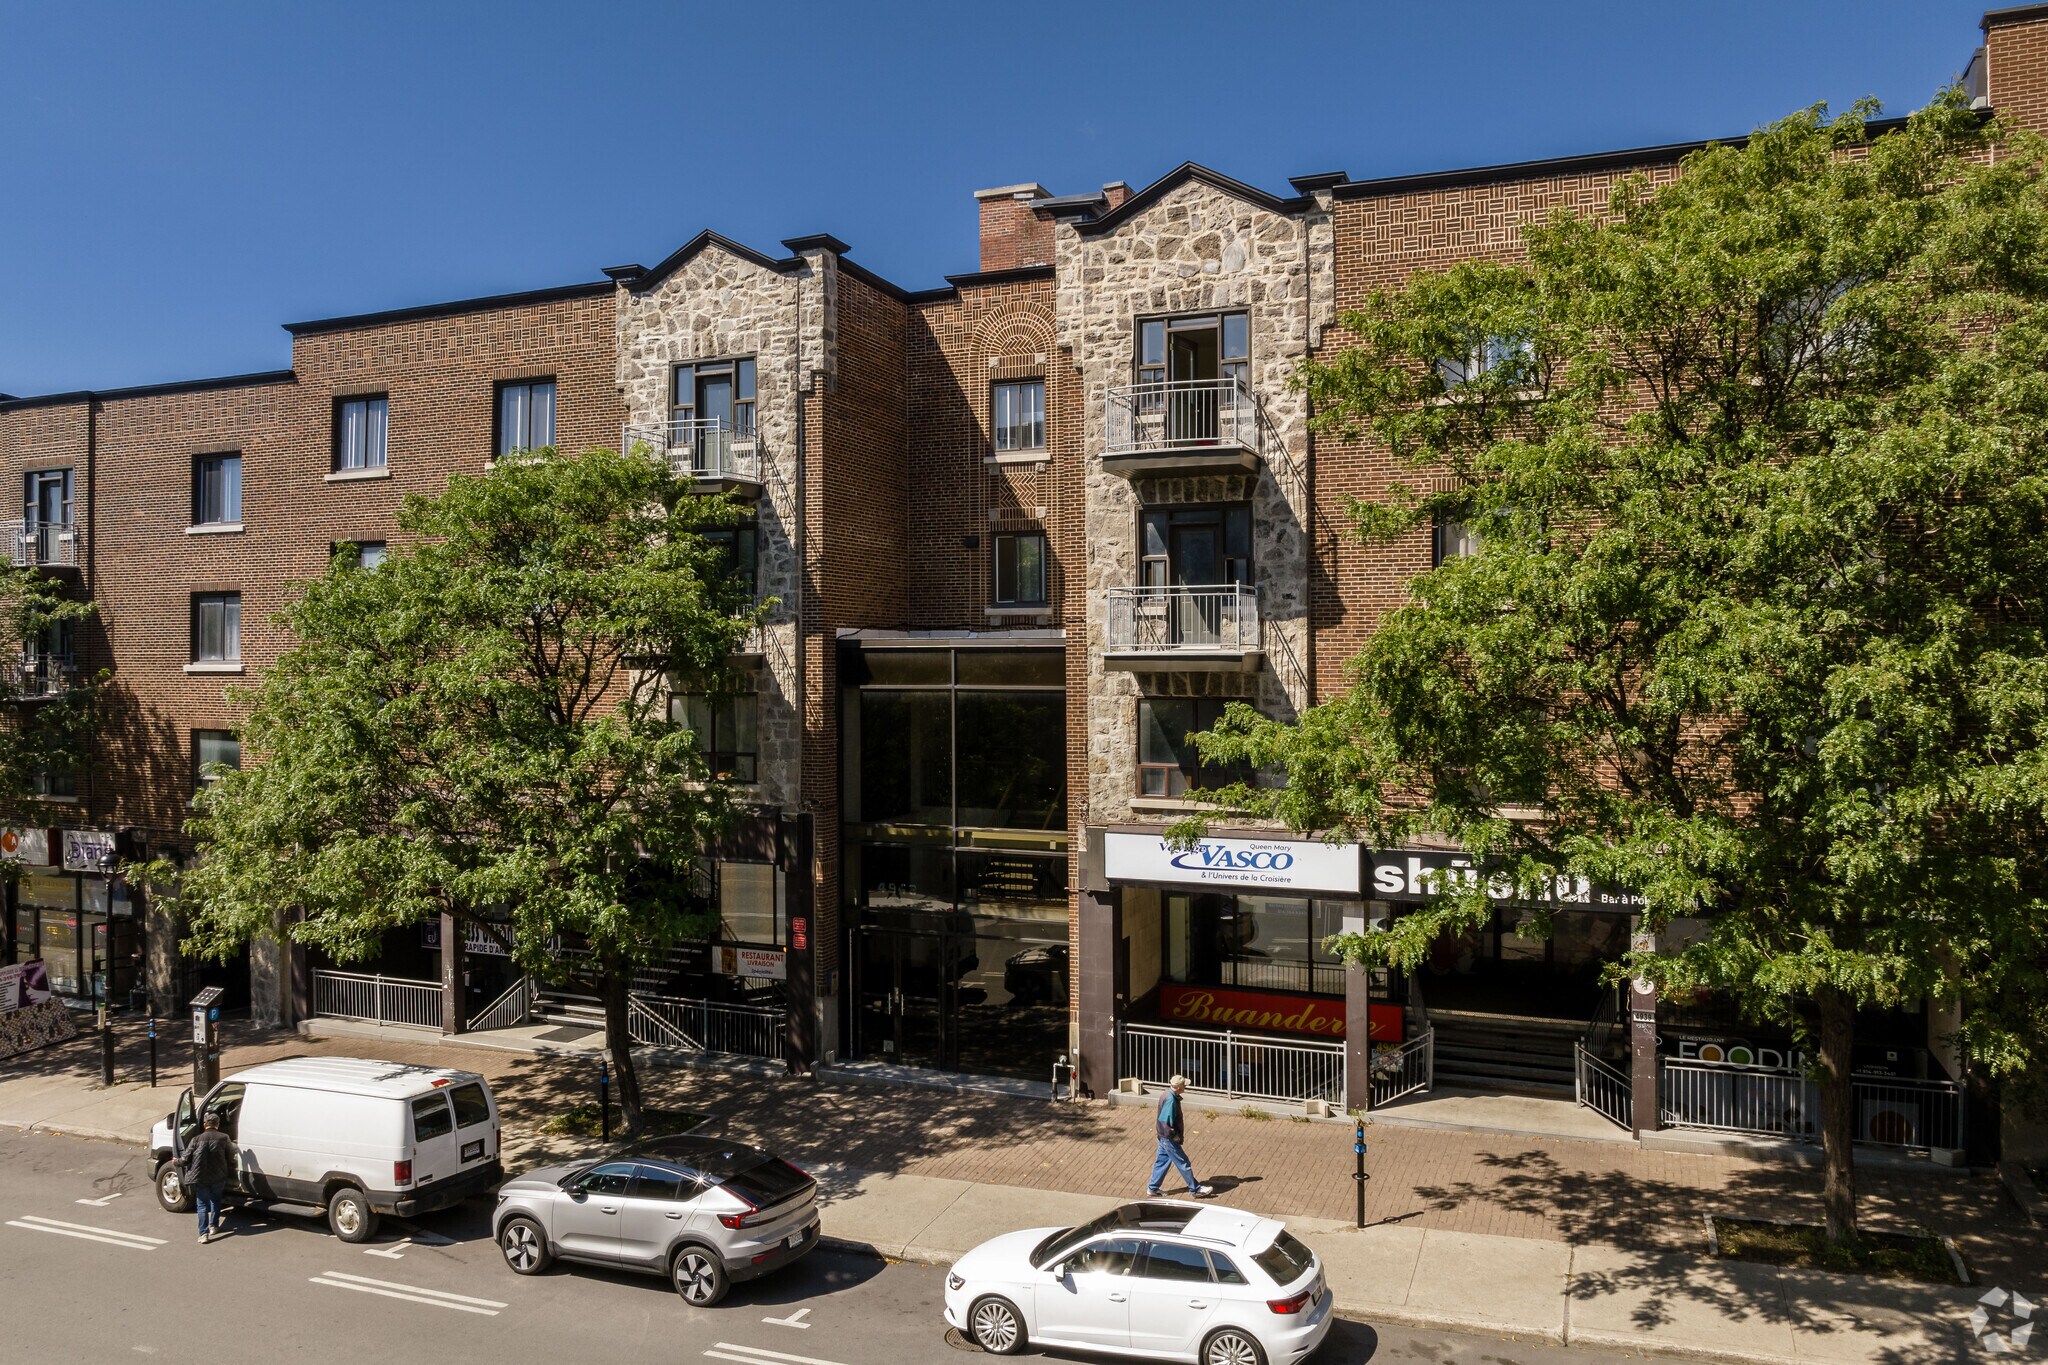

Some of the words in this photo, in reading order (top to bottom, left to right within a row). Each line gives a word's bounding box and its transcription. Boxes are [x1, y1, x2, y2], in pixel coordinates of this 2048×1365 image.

[71, 841, 111, 860] Dian
[1249, 843, 1272, 851] Queen
[1200, 844, 1294, 870] VASCO
[1208, 871, 1238, 880] l'Univers
[1240, 873, 1249, 881] de
[1251, 873, 1258, 881] la
[1601, 893, 1619, 904] Bar
[1621, 894, 1629, 904] à
[465, 942, 488, 953] RAPIDE
[741, 951, 784, 962] RESTAURANT
[747, 960, 775, 968] LIVRAISON
[211, 1009, 217, 1019] P
[1173, 991, 1386, 1036] Buandere
[1635, 1013, 1652, 1021] 4939
